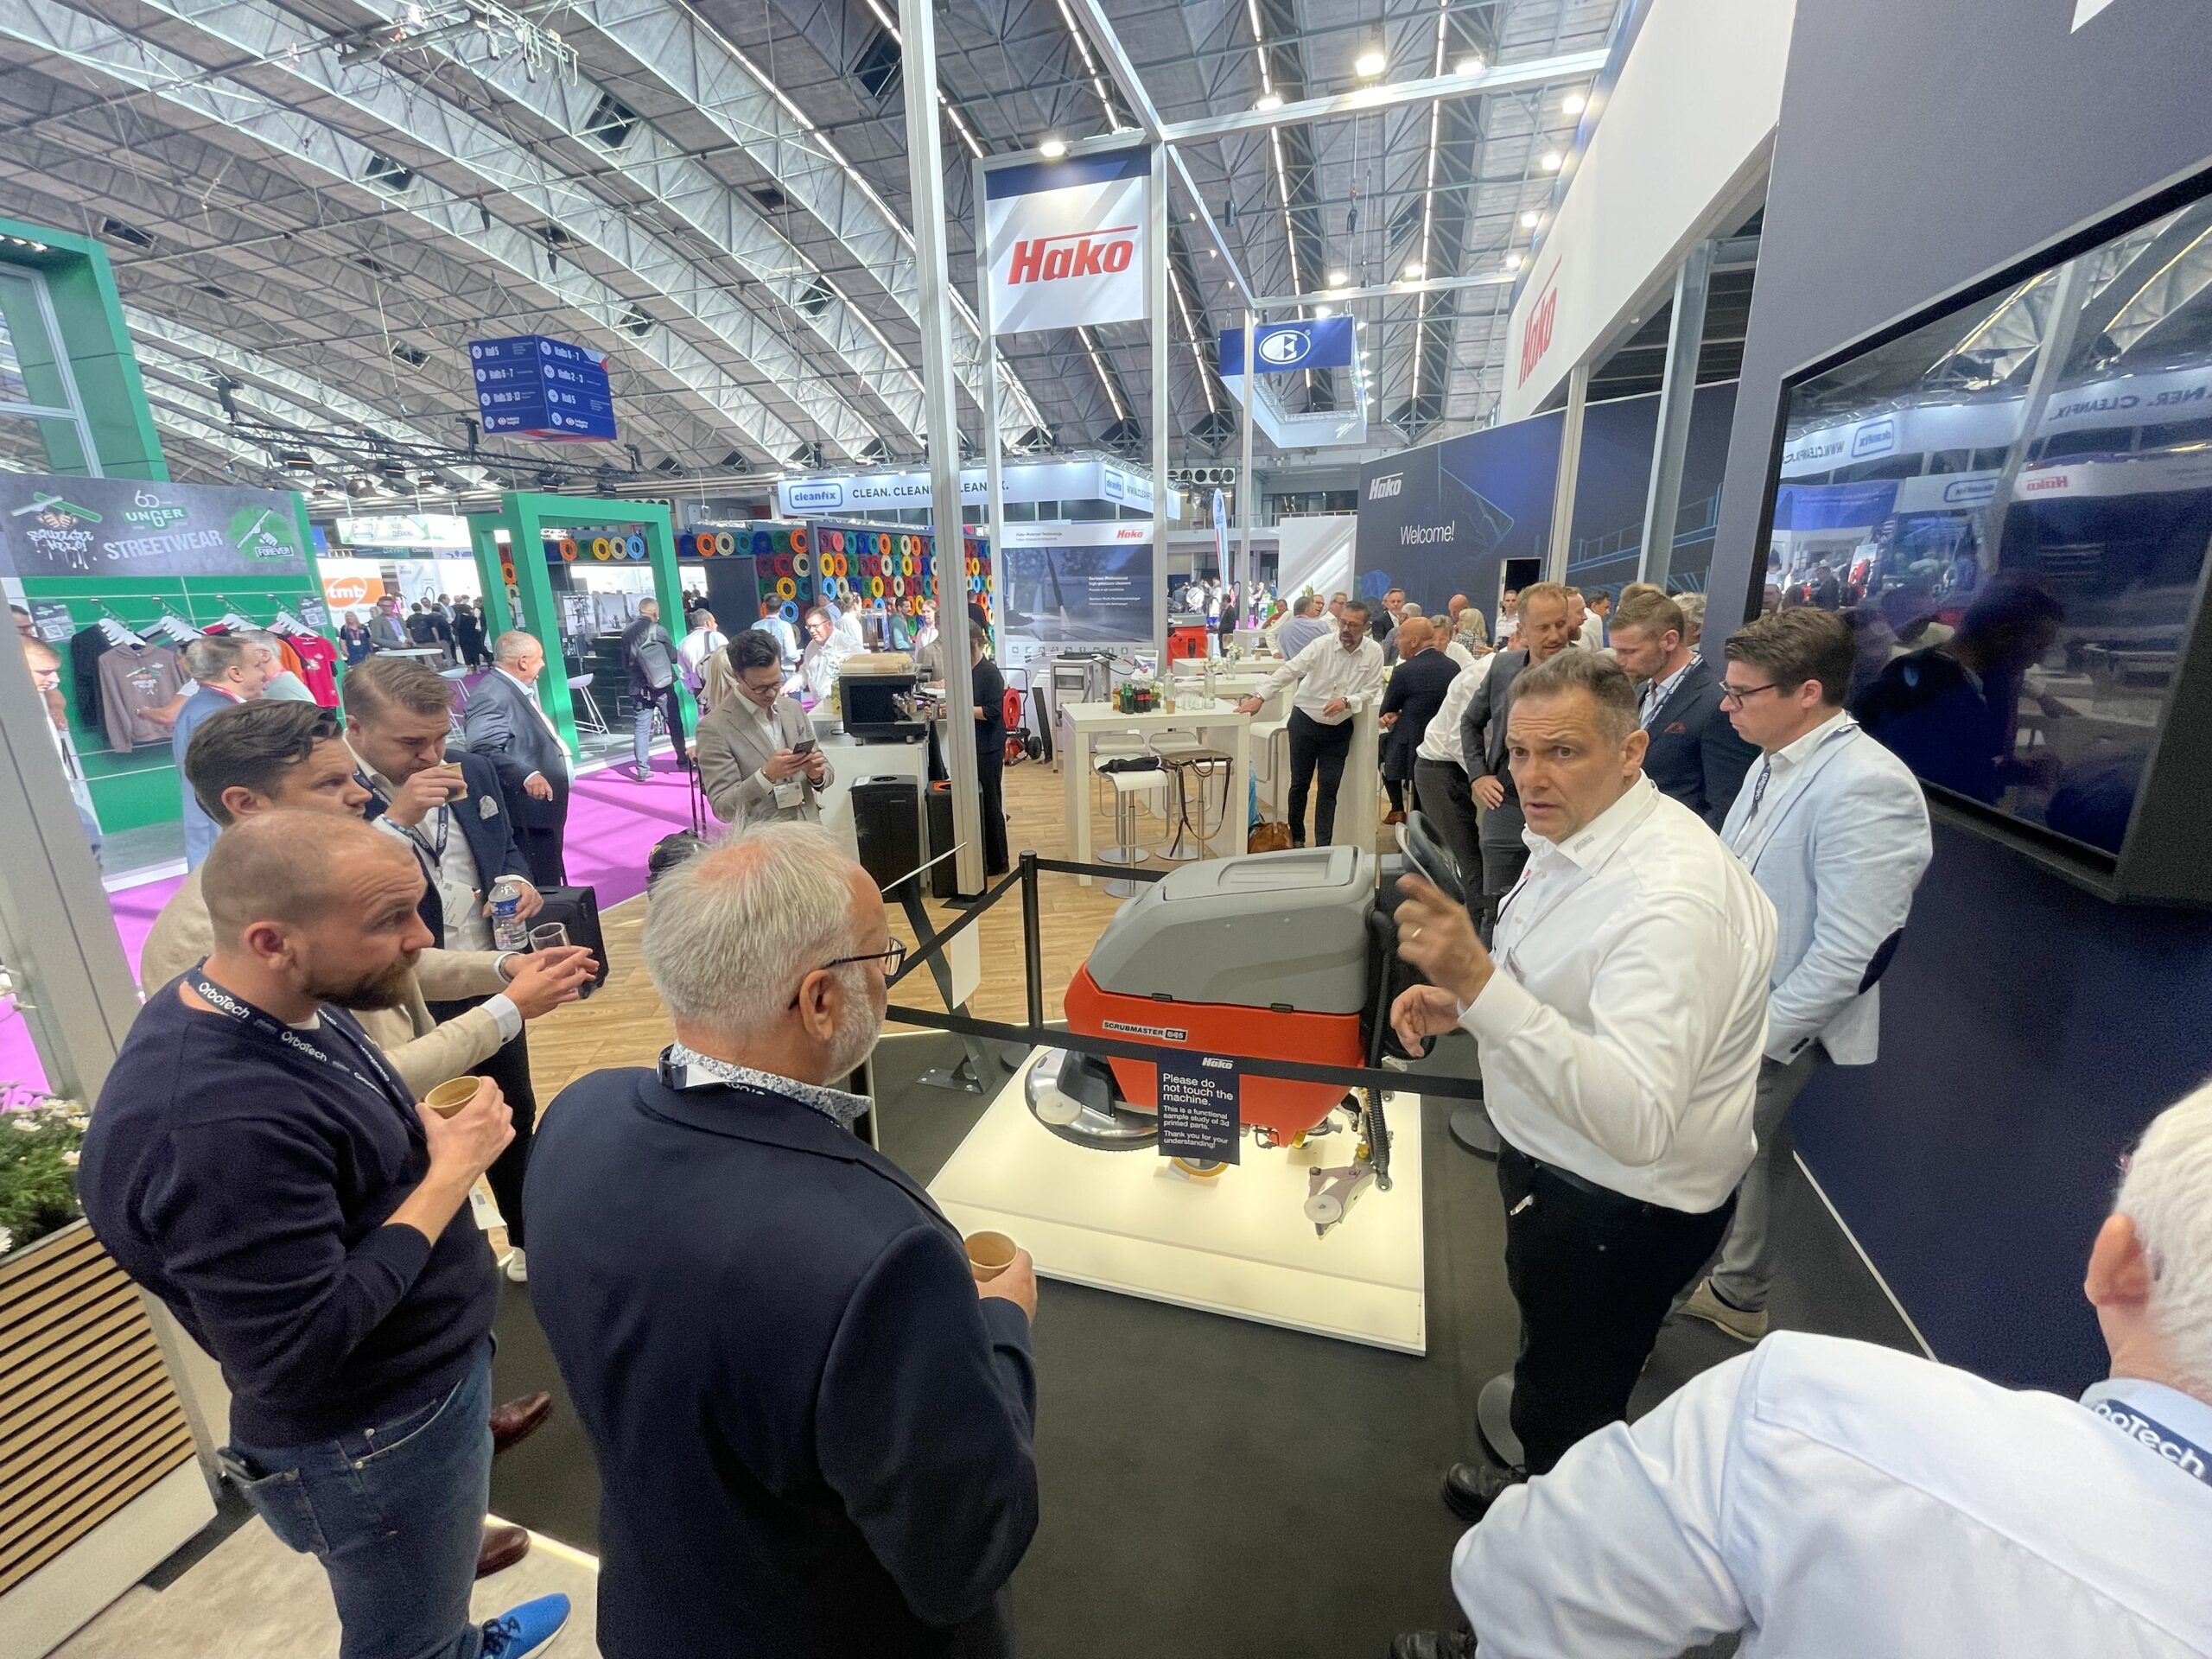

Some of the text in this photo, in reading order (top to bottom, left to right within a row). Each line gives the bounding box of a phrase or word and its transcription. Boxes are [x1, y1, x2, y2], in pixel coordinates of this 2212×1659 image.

[1007, 226, 1138, 285] Hako
[1518, 254, 1562, 390] Hako
[853, 488, 891, 498] CLEAN.
[893, 485, 932, 497] CLEAN
[1369, 472, 1404, 500] Hako
[794, 490, 836, 501] cleanfix
[125, 508, 184, 528] UNGER
[1116, 529, 1145, 538] Hako
[1401, 520, 1455, 544] Welcome!
[104, 530, 224, 560] STREETWEAR
[258, 546, 291, 556] FOREVER
[329, 585, 364, 598] tmb
[199, 982, 251, 1019] OrboTech
[1103, 1021, 1164, 1036] SCRUBMASTER
[281, 1031, 327, 1062] OrboTech
[1202, 1057, 1233, 1070] Hako
[1163, 1073, 1215, 1088] Please do
[1163, 1084, 1234, 1100] not touch the
[1163, 1093, 1211, 1106] machine.
[1190, 1115, 1210, 1124] study
[1193, 1109, 1228, 1119] functional
[1163, 1138, 1216, 1149] understanding!
